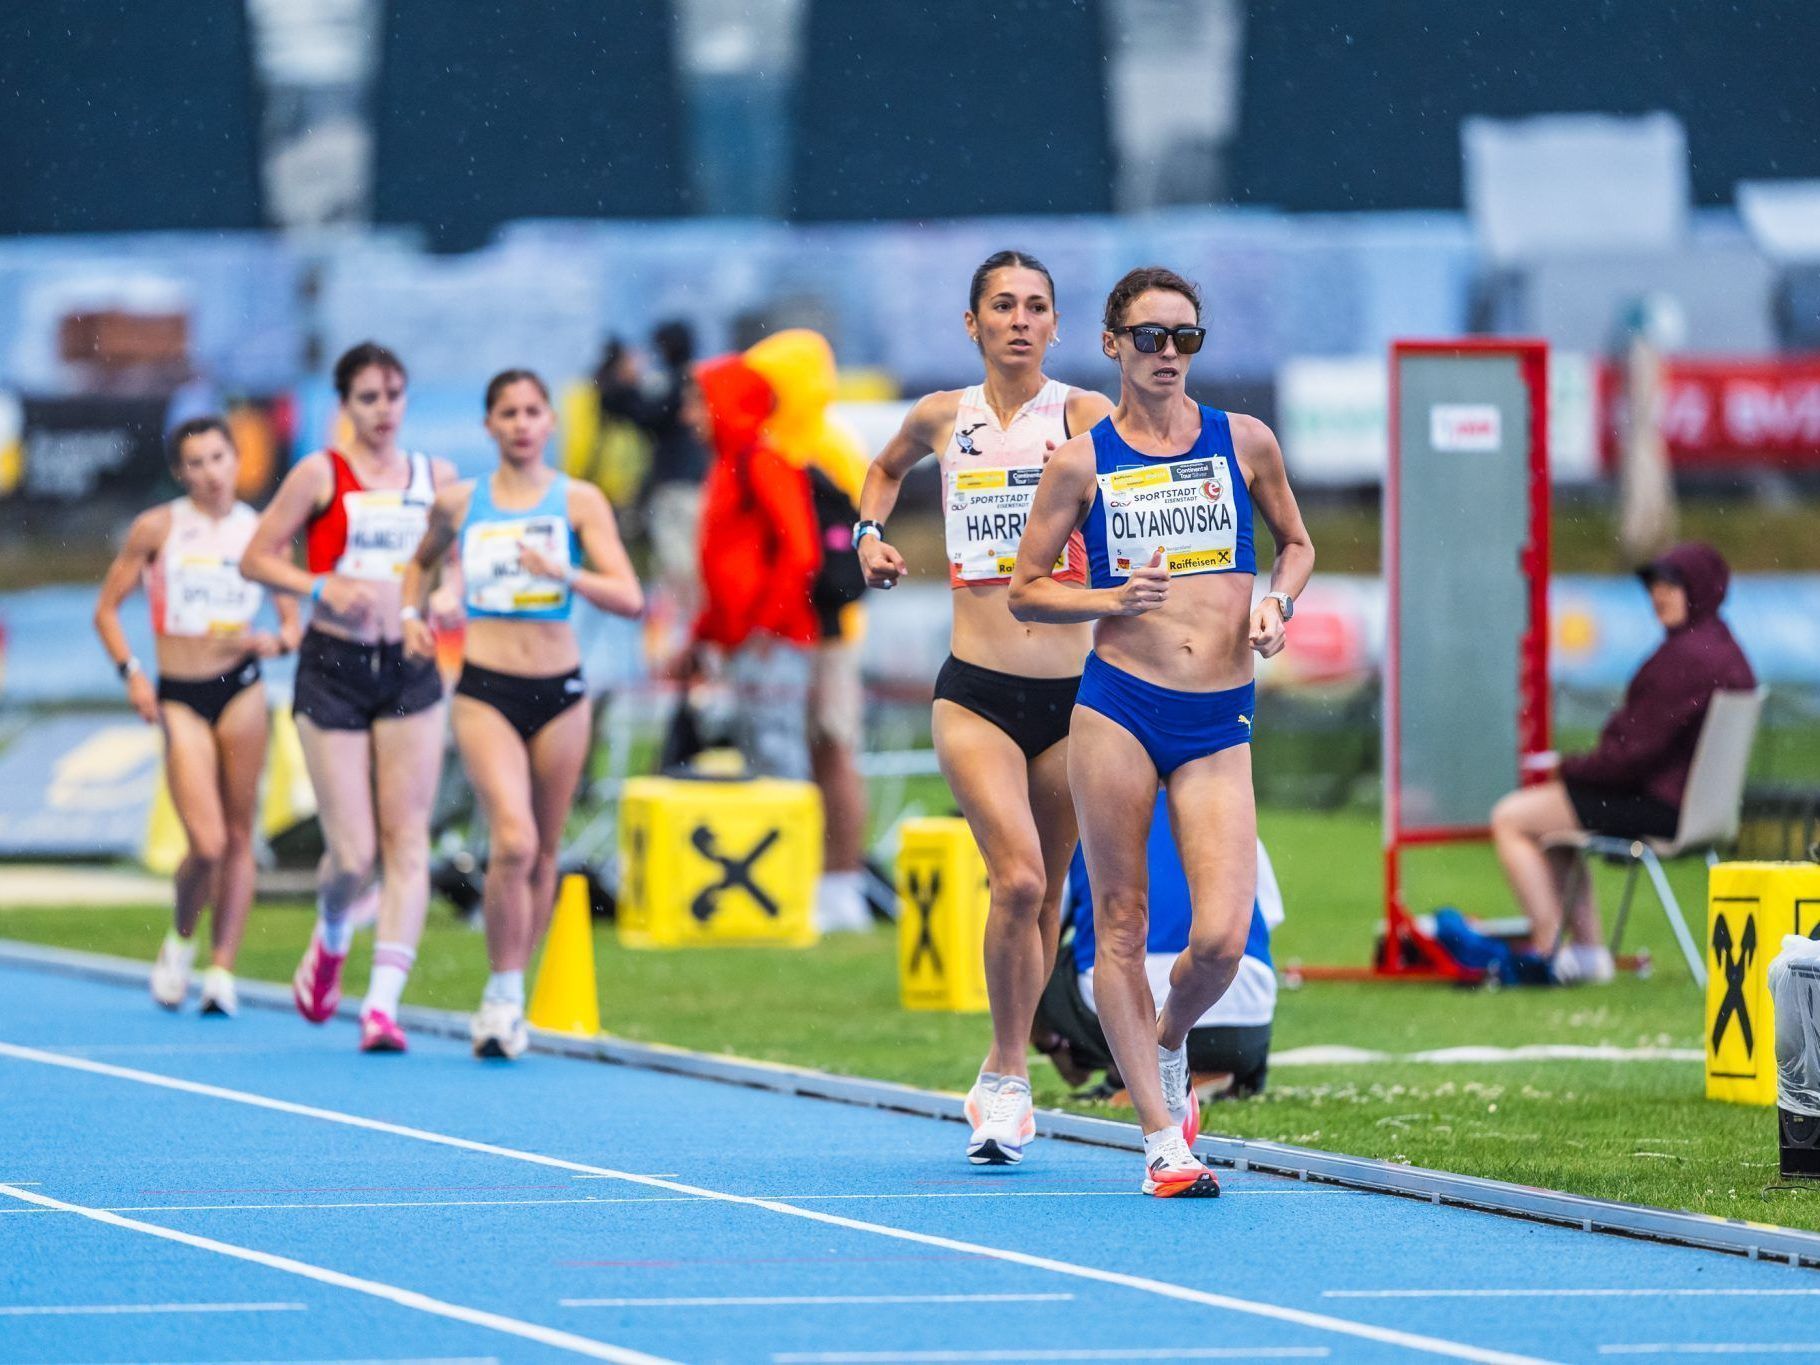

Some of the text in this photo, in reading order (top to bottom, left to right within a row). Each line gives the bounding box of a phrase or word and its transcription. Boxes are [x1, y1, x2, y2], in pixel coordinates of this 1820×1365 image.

[1176, 465, 1209, 474] Continental
[970, 493, 1029, 505] SPORTSTADT
[1134, 487, 1197, 502] SPORTSTADT
[1164, 496, 1198, 504] EISENSTADT
[1112, 503, 1232, 539] OLYANOVSKA
[1169, 557, 1216, 570] Raiffeisen
